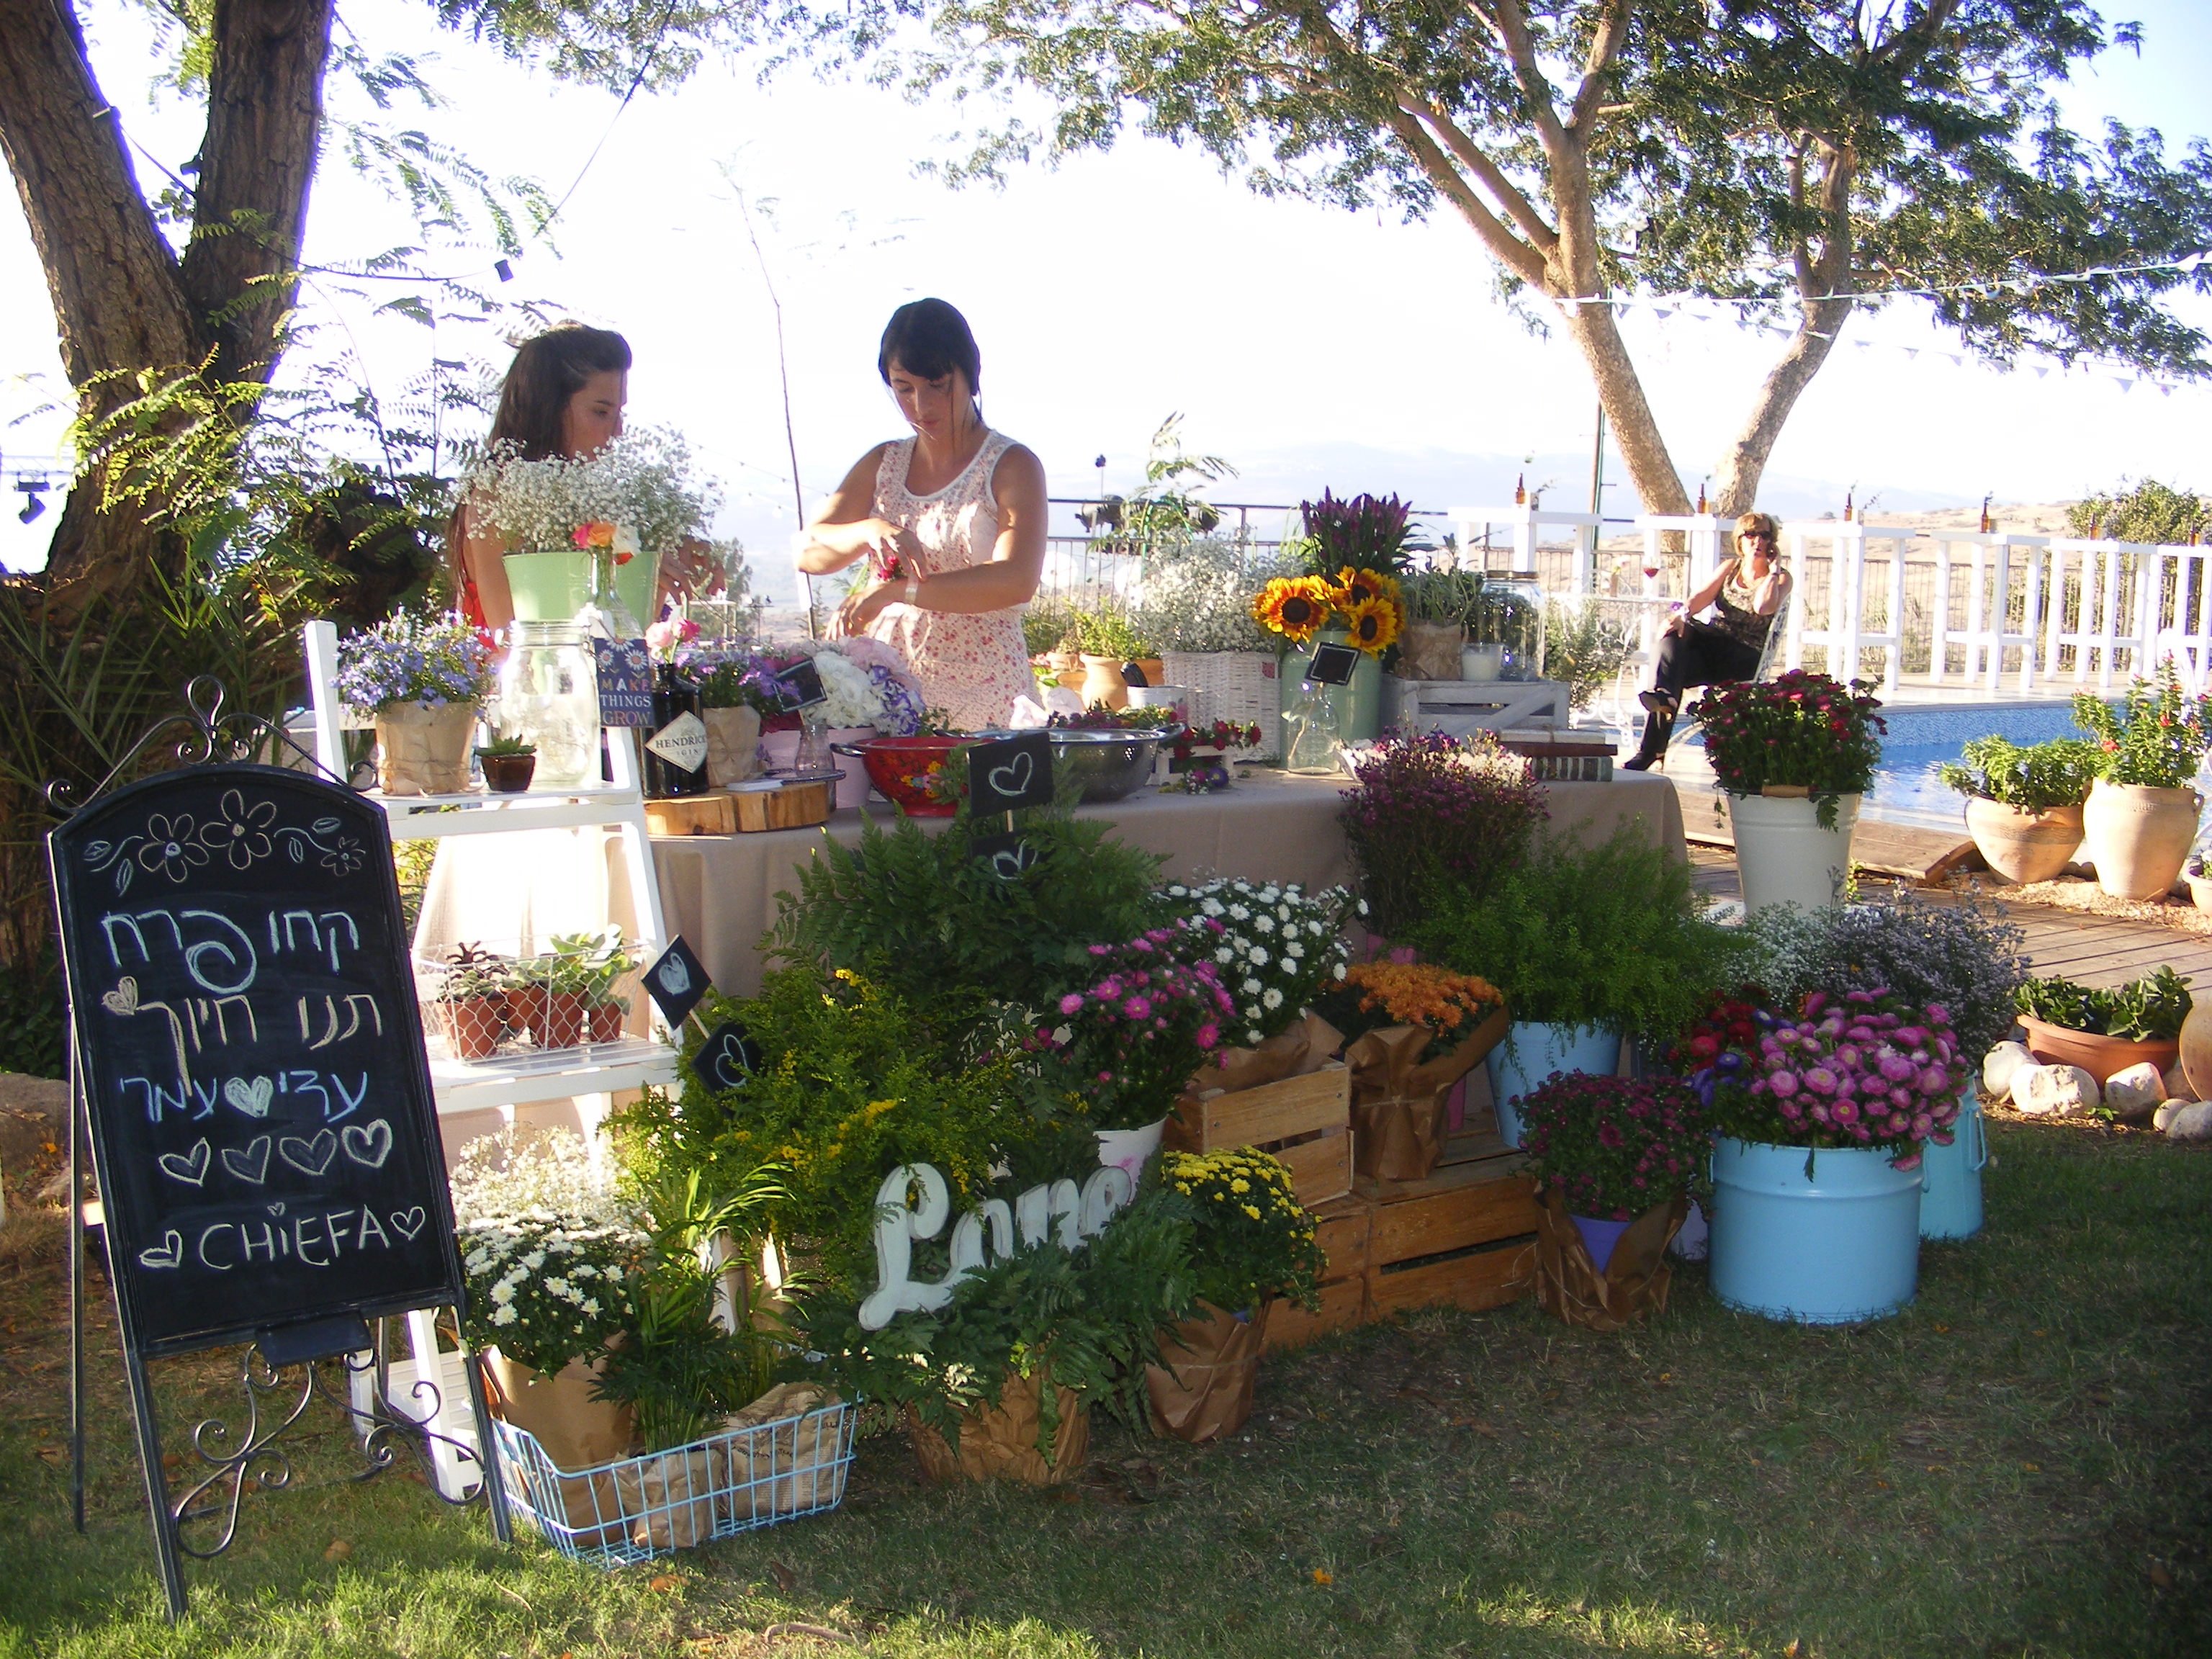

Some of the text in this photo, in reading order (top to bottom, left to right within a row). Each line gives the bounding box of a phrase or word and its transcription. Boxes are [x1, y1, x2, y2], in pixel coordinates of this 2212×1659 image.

[600, 694, 652, 708] THINGS
[601, 678, 650, 692] MAKE
[602, 710, 651, 726] GROW
[102, 908, 360, 995] קחו פרח
[135, 994, 383, 1098] תנו חיוך
[278, 1069, 368, 1123] עדי
